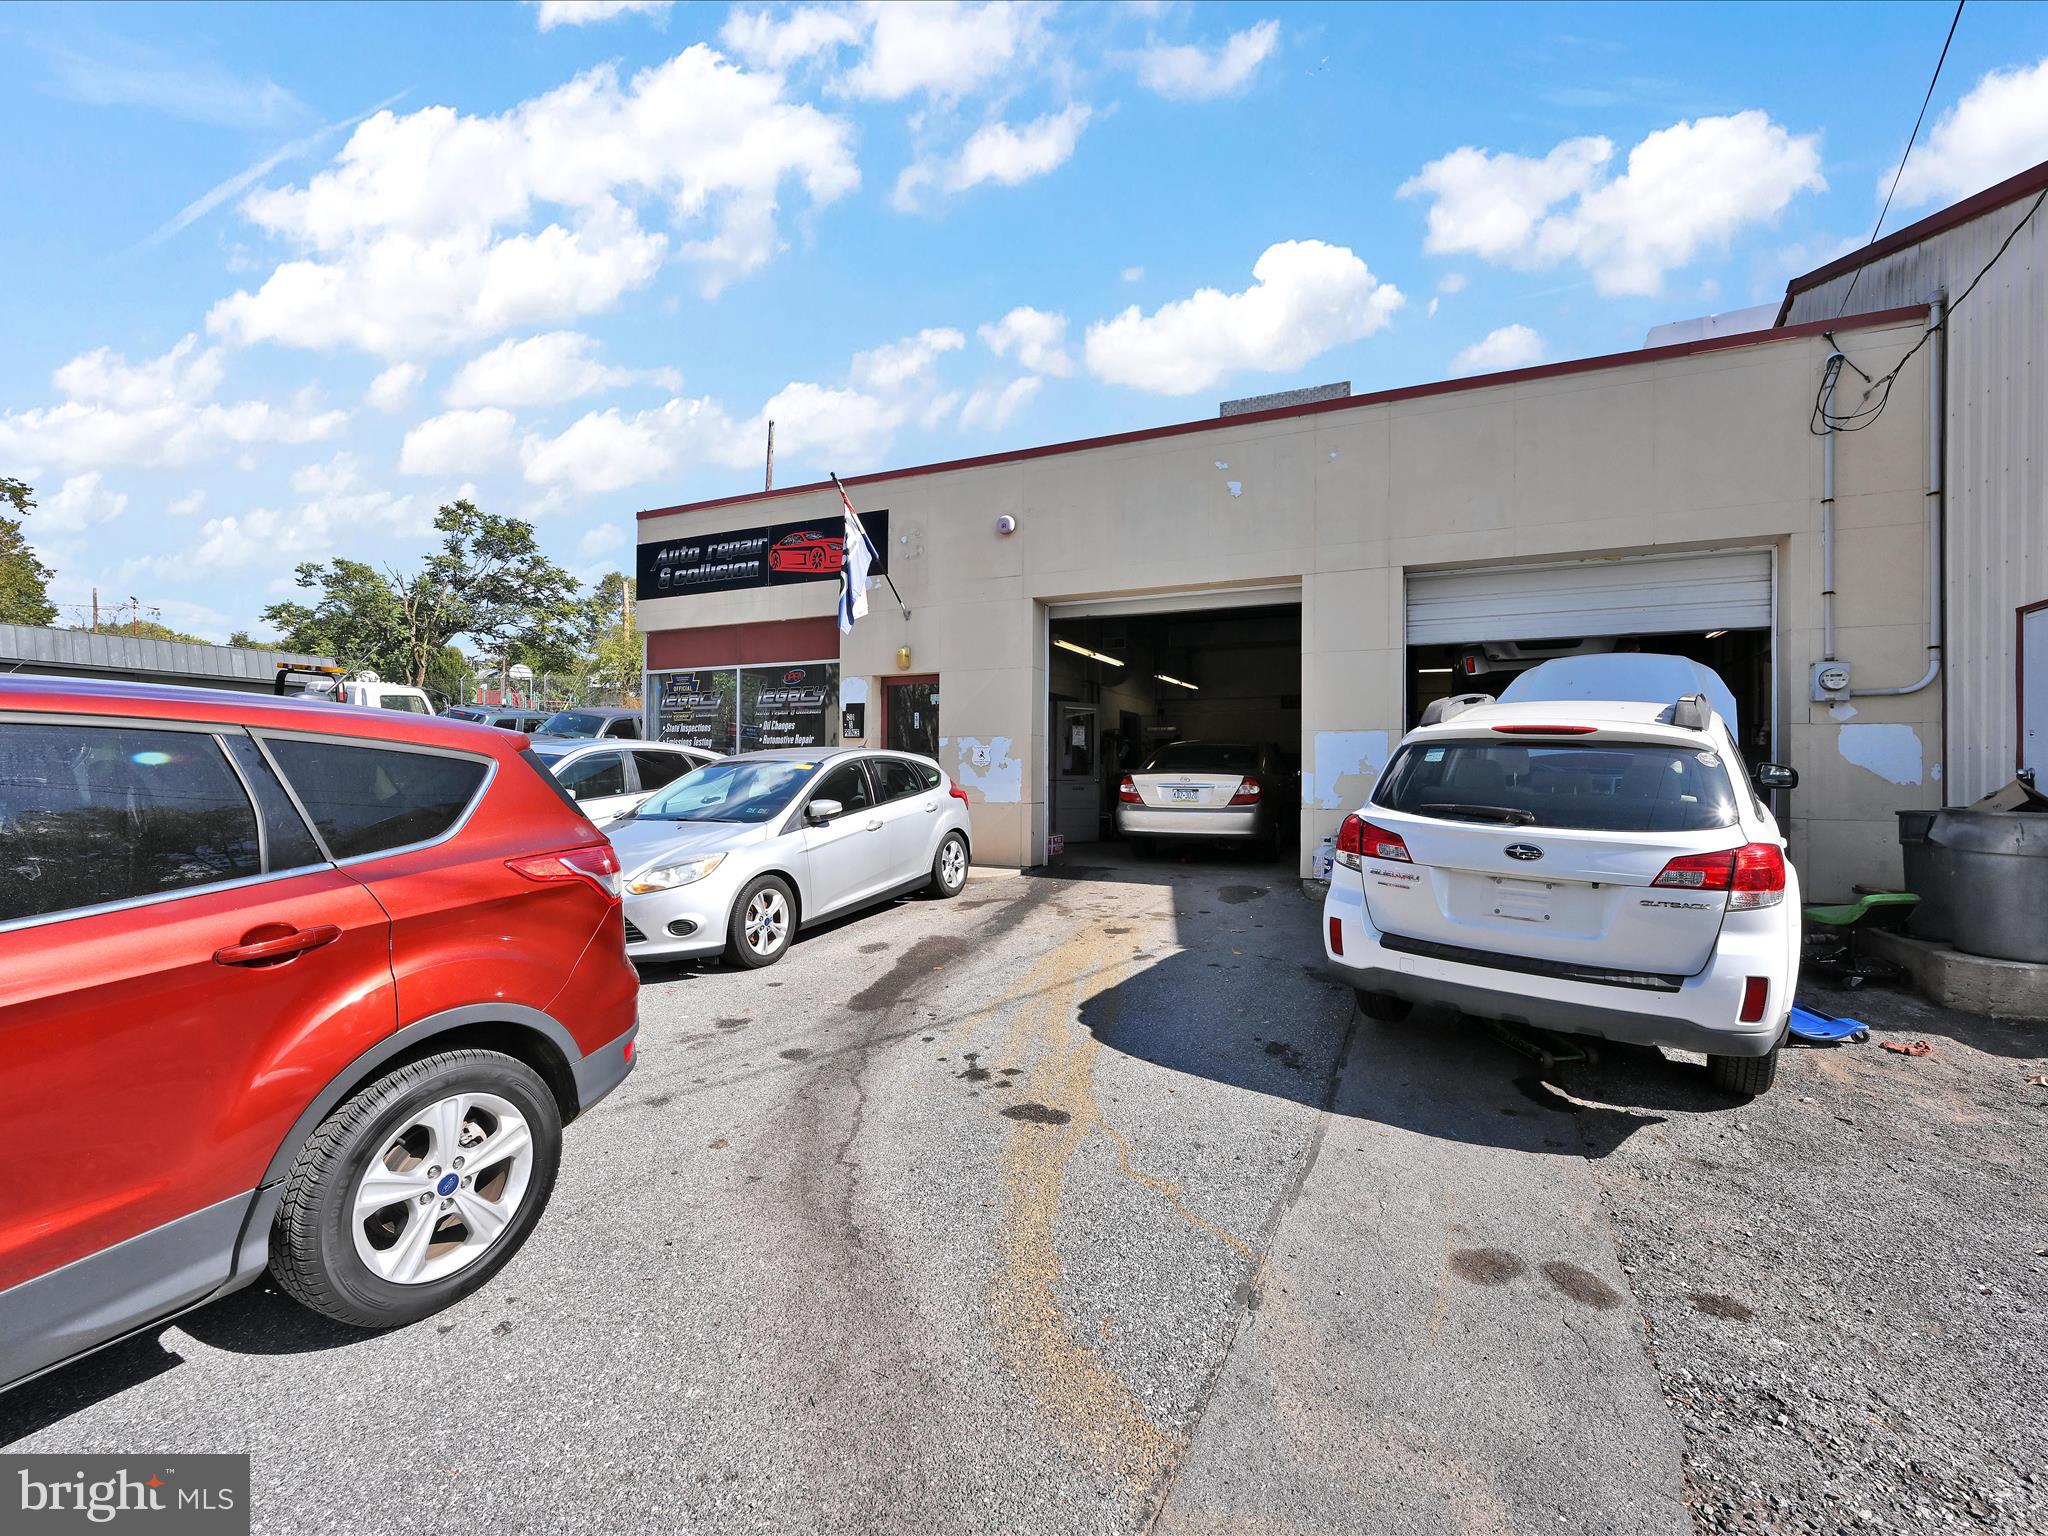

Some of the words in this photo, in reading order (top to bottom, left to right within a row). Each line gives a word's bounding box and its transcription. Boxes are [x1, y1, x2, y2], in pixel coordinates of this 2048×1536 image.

[650, 545, 700, 572] Auto
[705, 537, 768, 560] repair
[673, 560, 760, 585] collision
[666, 722, 679, 732] State
[680, 722, 711, 734] Inspections
[763, 720, 771, 730] Oil
[771, 720, 796, 732] Changes
[693, 736, 713, 748] Testing
[763, 734, 794, 745] Automotive
[794, 733, 815, 746] Repair
[1639, 899, 1711, 910] OUTBACK
